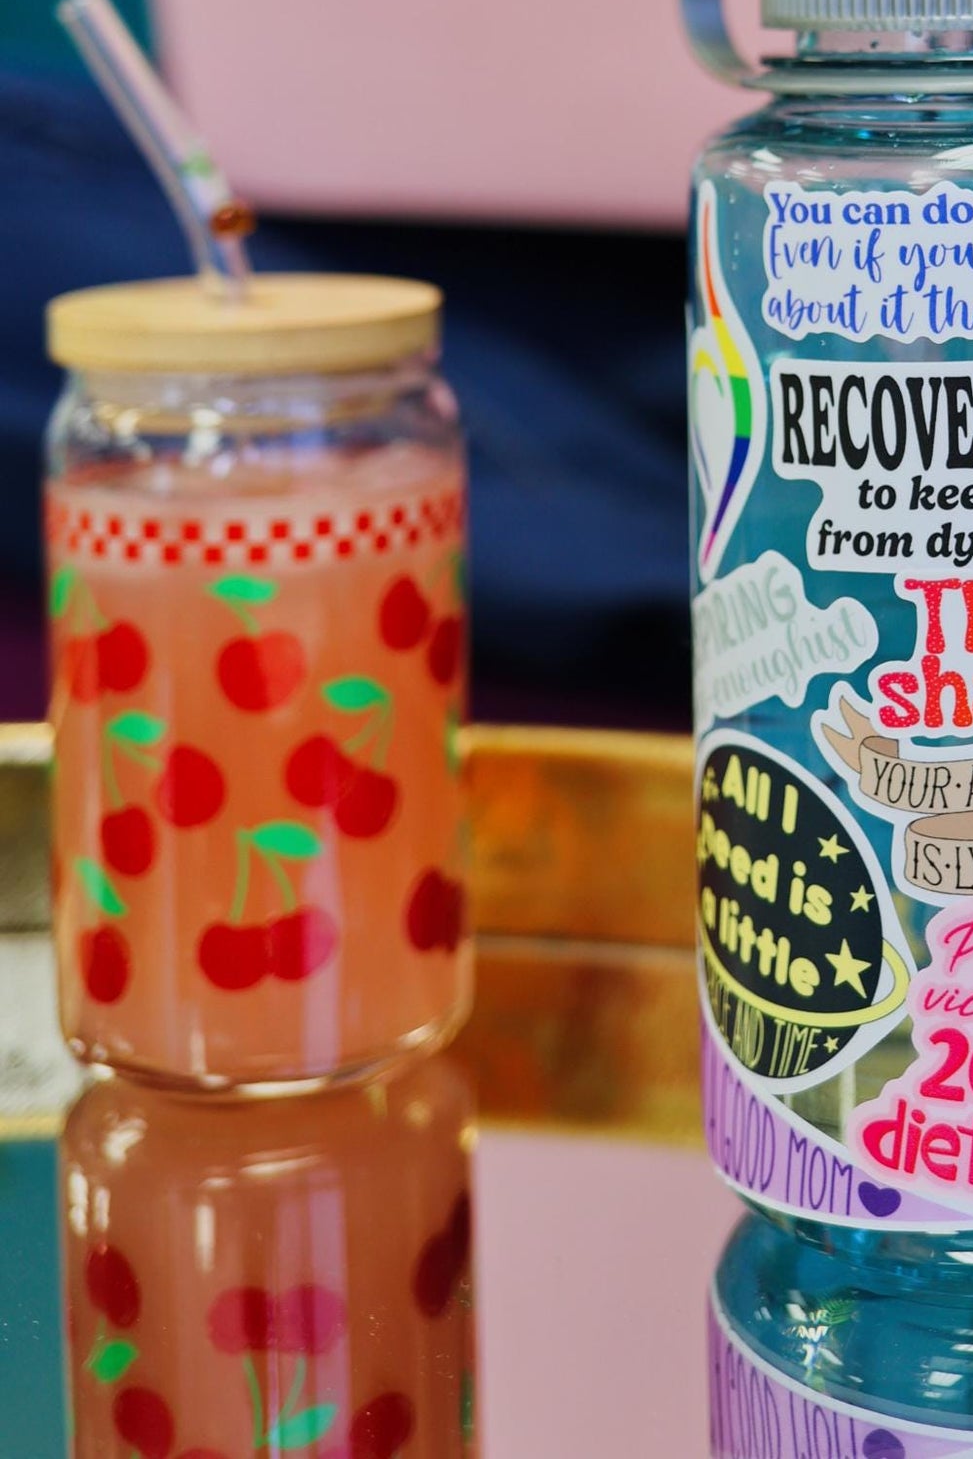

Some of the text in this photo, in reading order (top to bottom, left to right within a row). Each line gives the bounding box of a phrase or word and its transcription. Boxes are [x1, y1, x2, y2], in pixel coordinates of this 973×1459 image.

[770, 193, 832, 224] You
[842, 202, 911, 225] can
[770, 225, 842, 280] Even
[854, 228, 885, 283] if
[768, 284, 867, 334] about
[880, 284, 914, 334] it
[858, 479, 897, 510] to
[817, 519, 914, 558] from
[721, 754, 799, 834] All I
[872, 757, 951, 809] YOUR
[912, 841, 943, 887] IS
[789, 860, 833, 925] is
[719, 897, 820, 997] little
[768, 1017, 823, 1078] TIME
[786, 1127, 853, 1216] MOM
